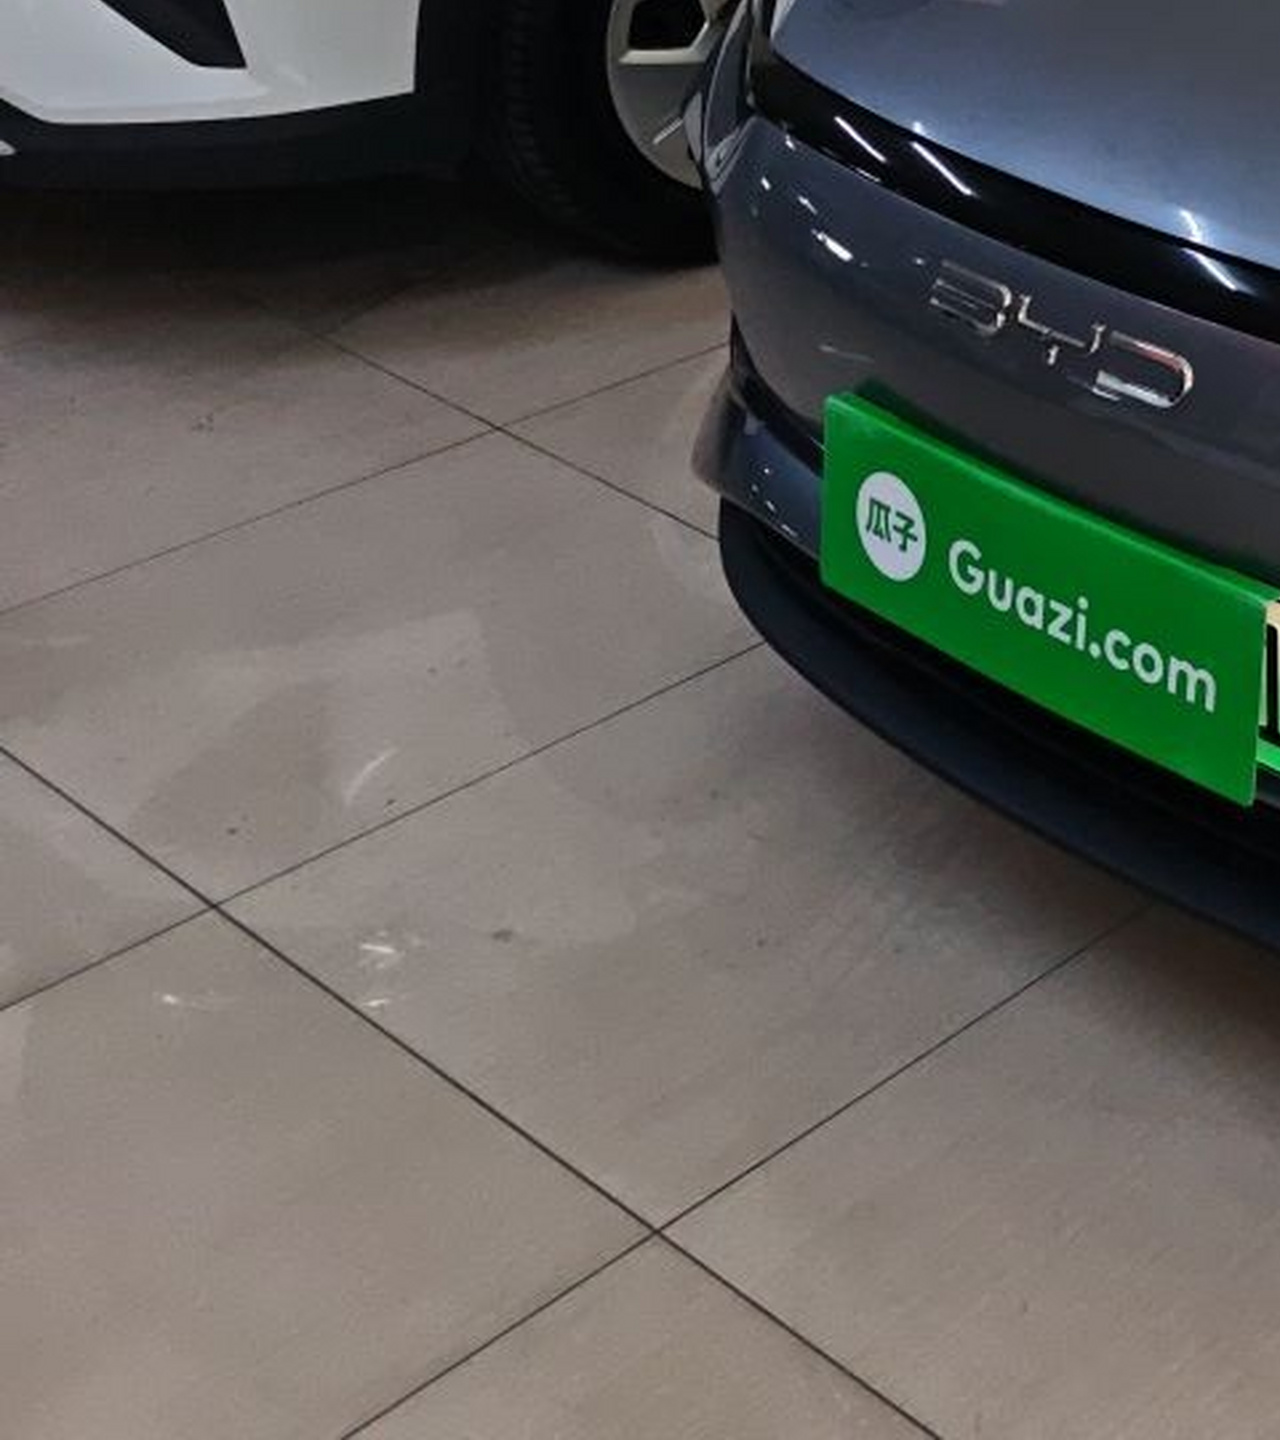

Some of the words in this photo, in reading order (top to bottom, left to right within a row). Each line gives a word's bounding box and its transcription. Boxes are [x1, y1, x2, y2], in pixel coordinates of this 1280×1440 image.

[929, 259, 1194, 409] BYD
[865, 497, 919, 553] 瓜子
[948, 538, 1218, 714] Guazi.com
